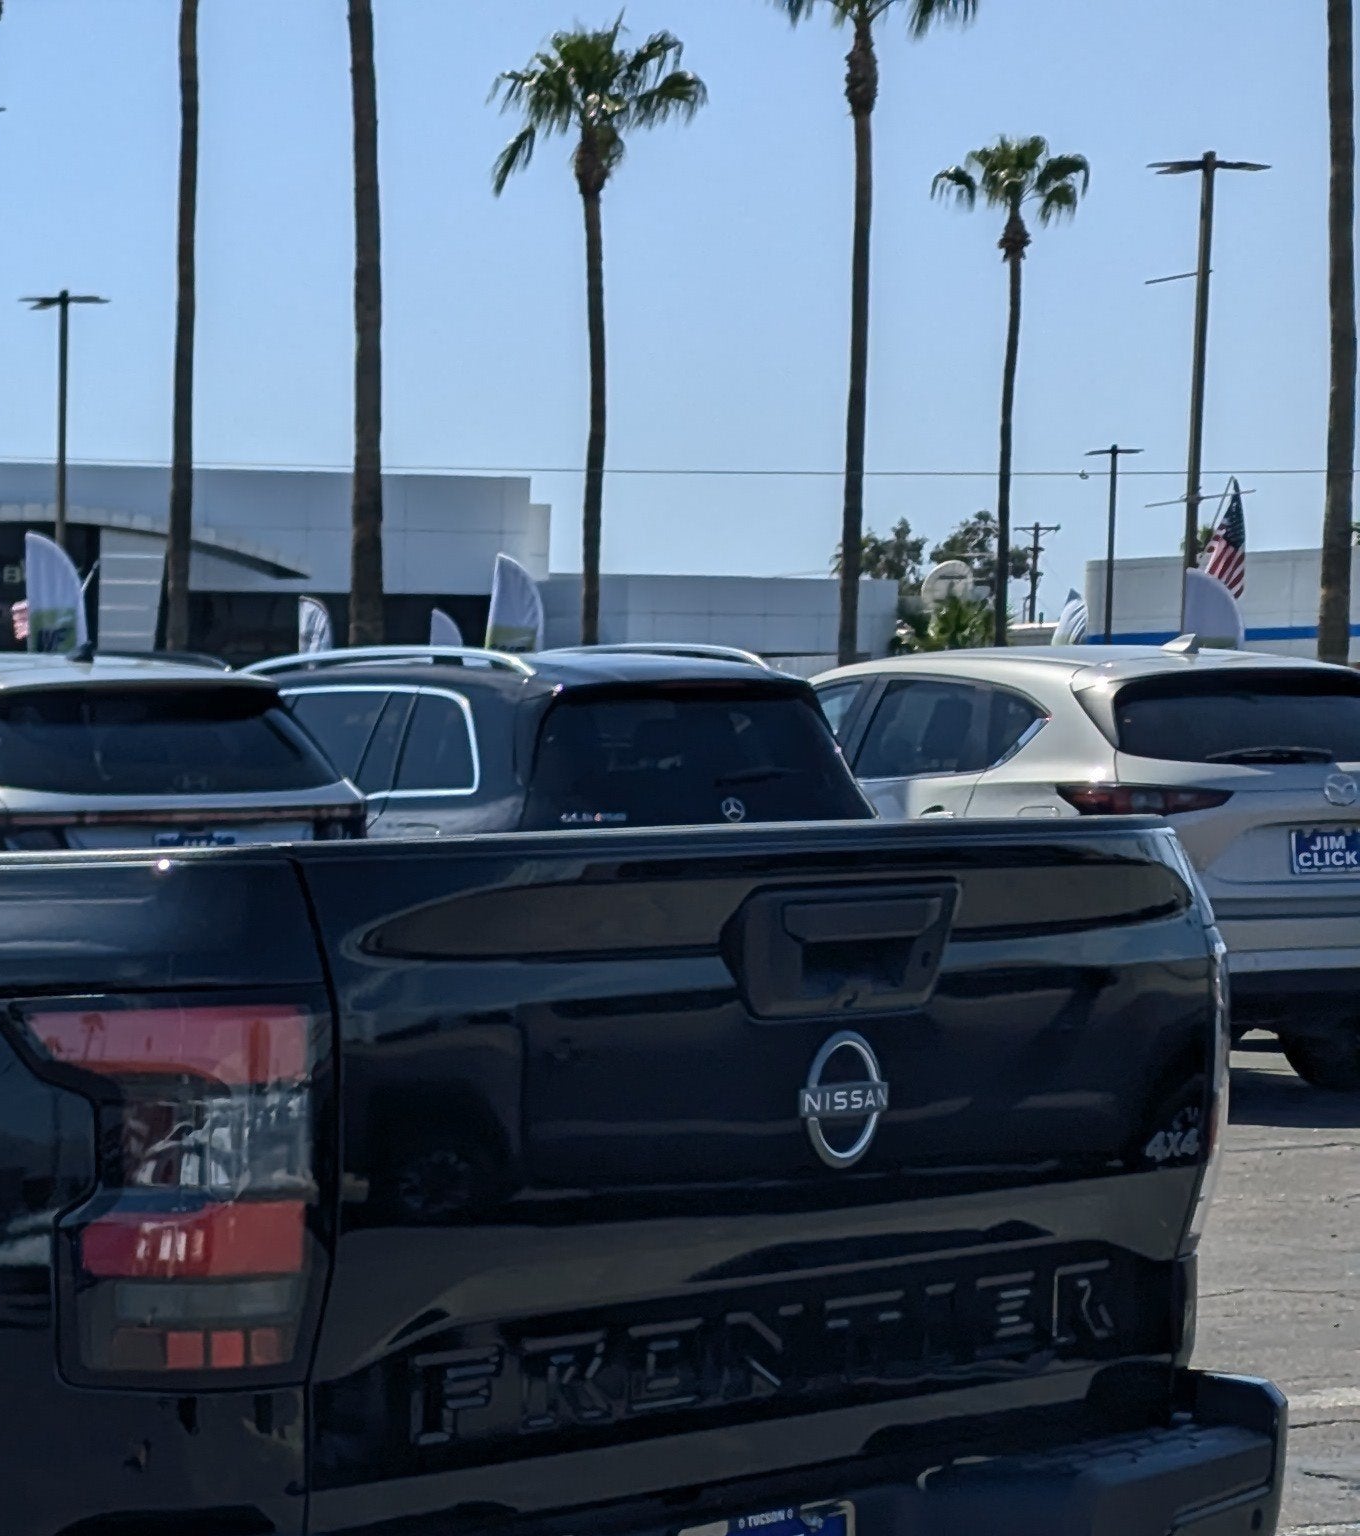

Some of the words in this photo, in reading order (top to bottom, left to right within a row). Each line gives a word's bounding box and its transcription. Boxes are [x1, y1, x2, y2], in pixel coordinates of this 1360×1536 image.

[1310, 835, 1346, 850] JIM
[1298, 850, 1358, 867] CLICK
[803, 1089, 888, 1114] NISSAN
[408, 1257, 1116, 1446] FRONTIER
[748, 1510, 785, 1527] TUCSON
